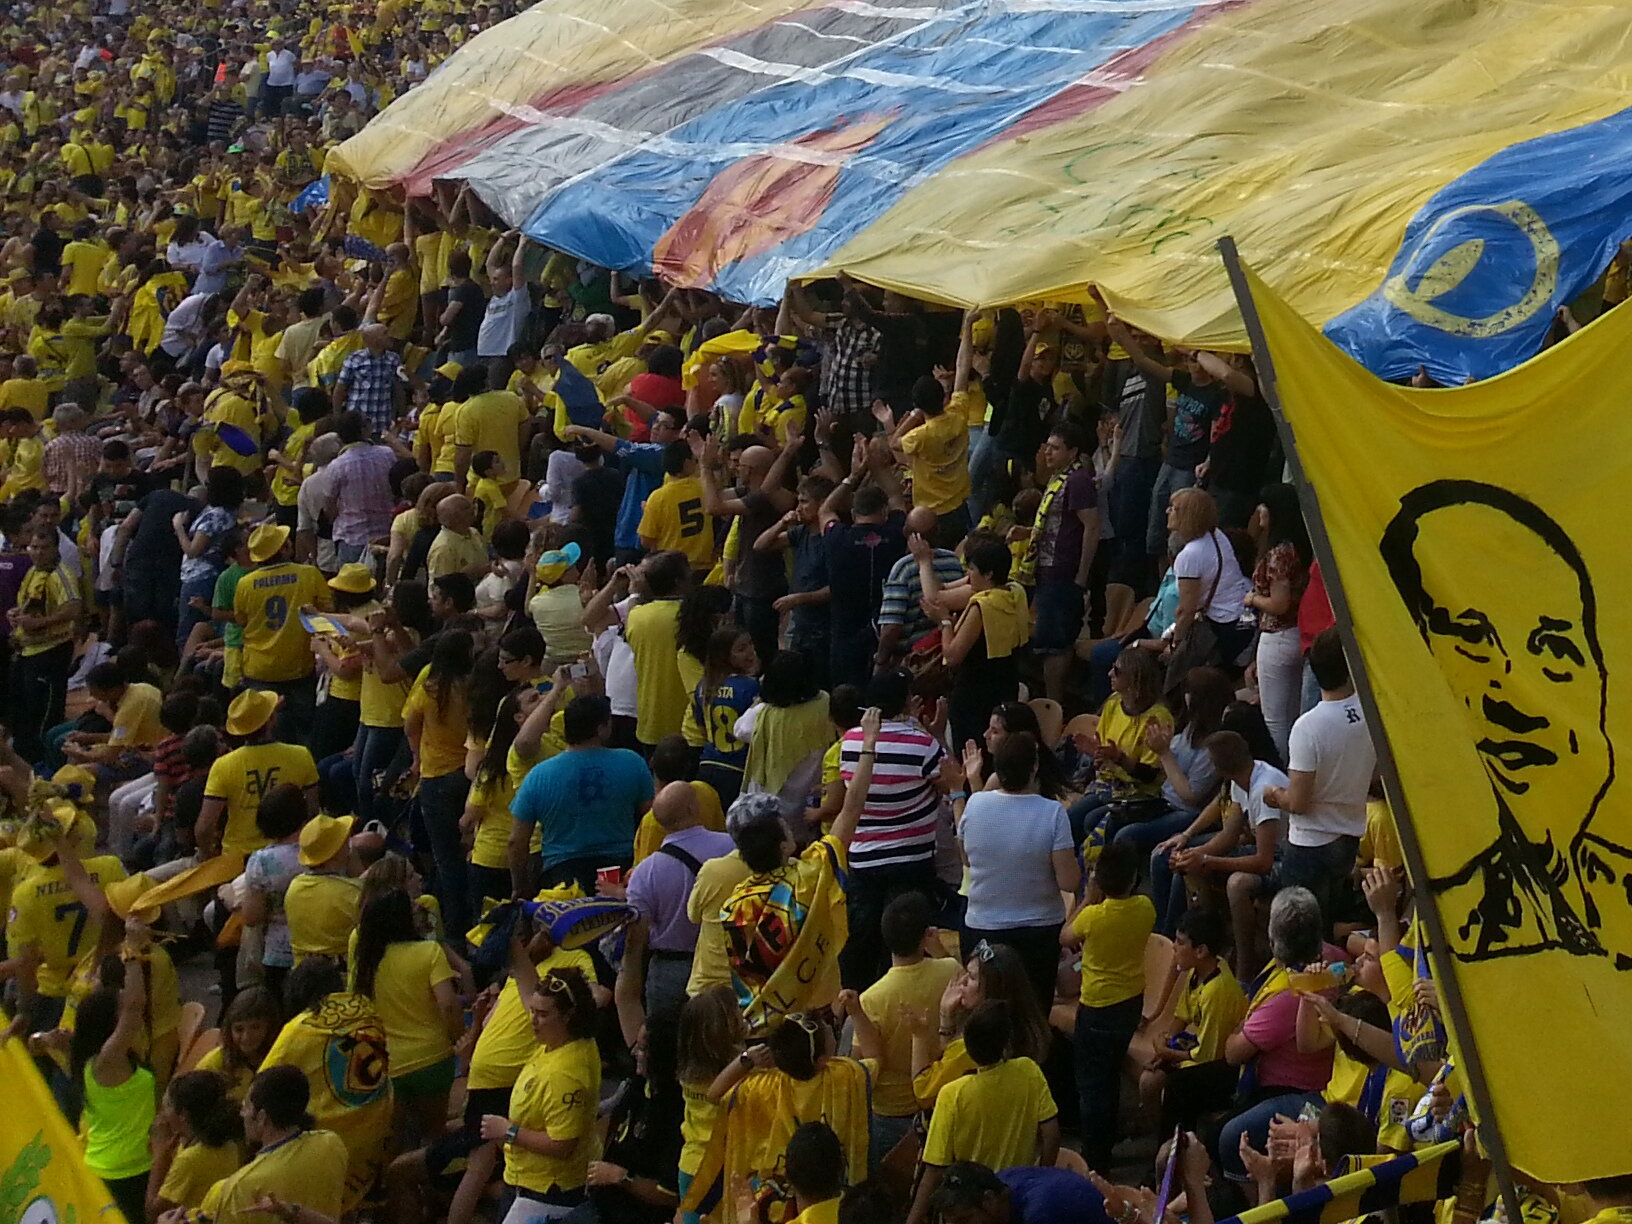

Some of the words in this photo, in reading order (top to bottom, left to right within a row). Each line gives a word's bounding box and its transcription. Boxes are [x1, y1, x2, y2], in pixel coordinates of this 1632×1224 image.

[677, 497, 706, 537] 5
[253, 573, 298, 590] PALERMO
[265, 595, 288, 630] 9
[37, 872, 100, 898] NILR
[55, 901, 89, 958] 7
